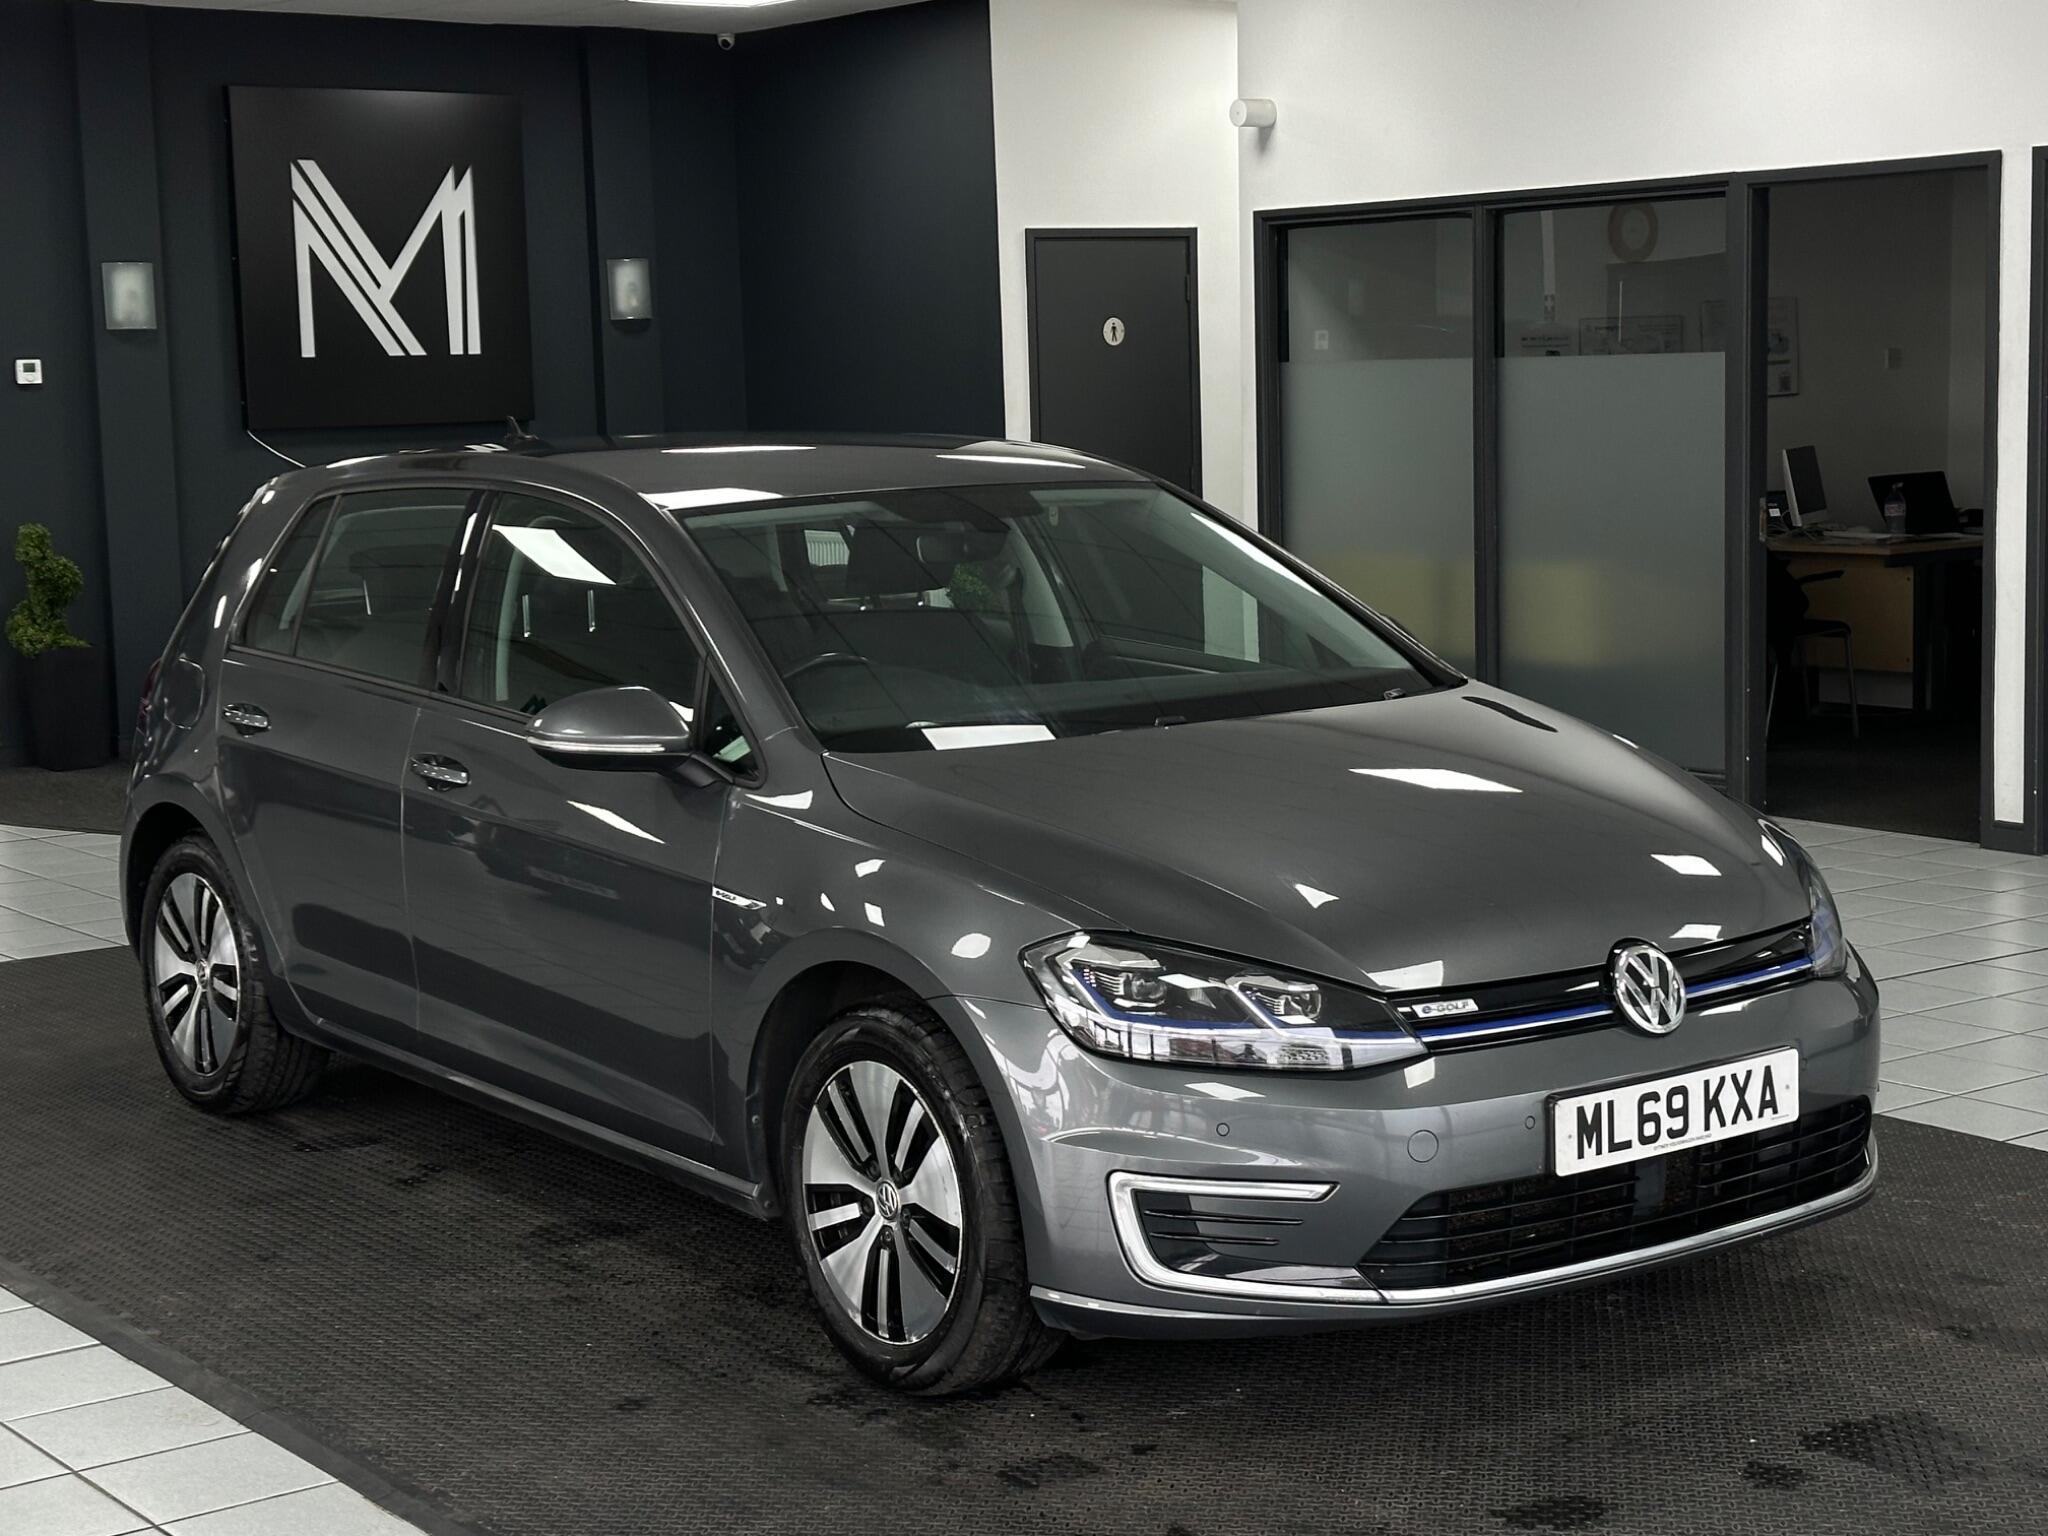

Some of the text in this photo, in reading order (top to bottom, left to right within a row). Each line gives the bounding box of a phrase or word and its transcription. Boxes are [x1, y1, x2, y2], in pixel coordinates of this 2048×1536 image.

[1615, 946, 1686, 1034] VW
[1576, 1065, 1779, 1160] ML69 KXA
